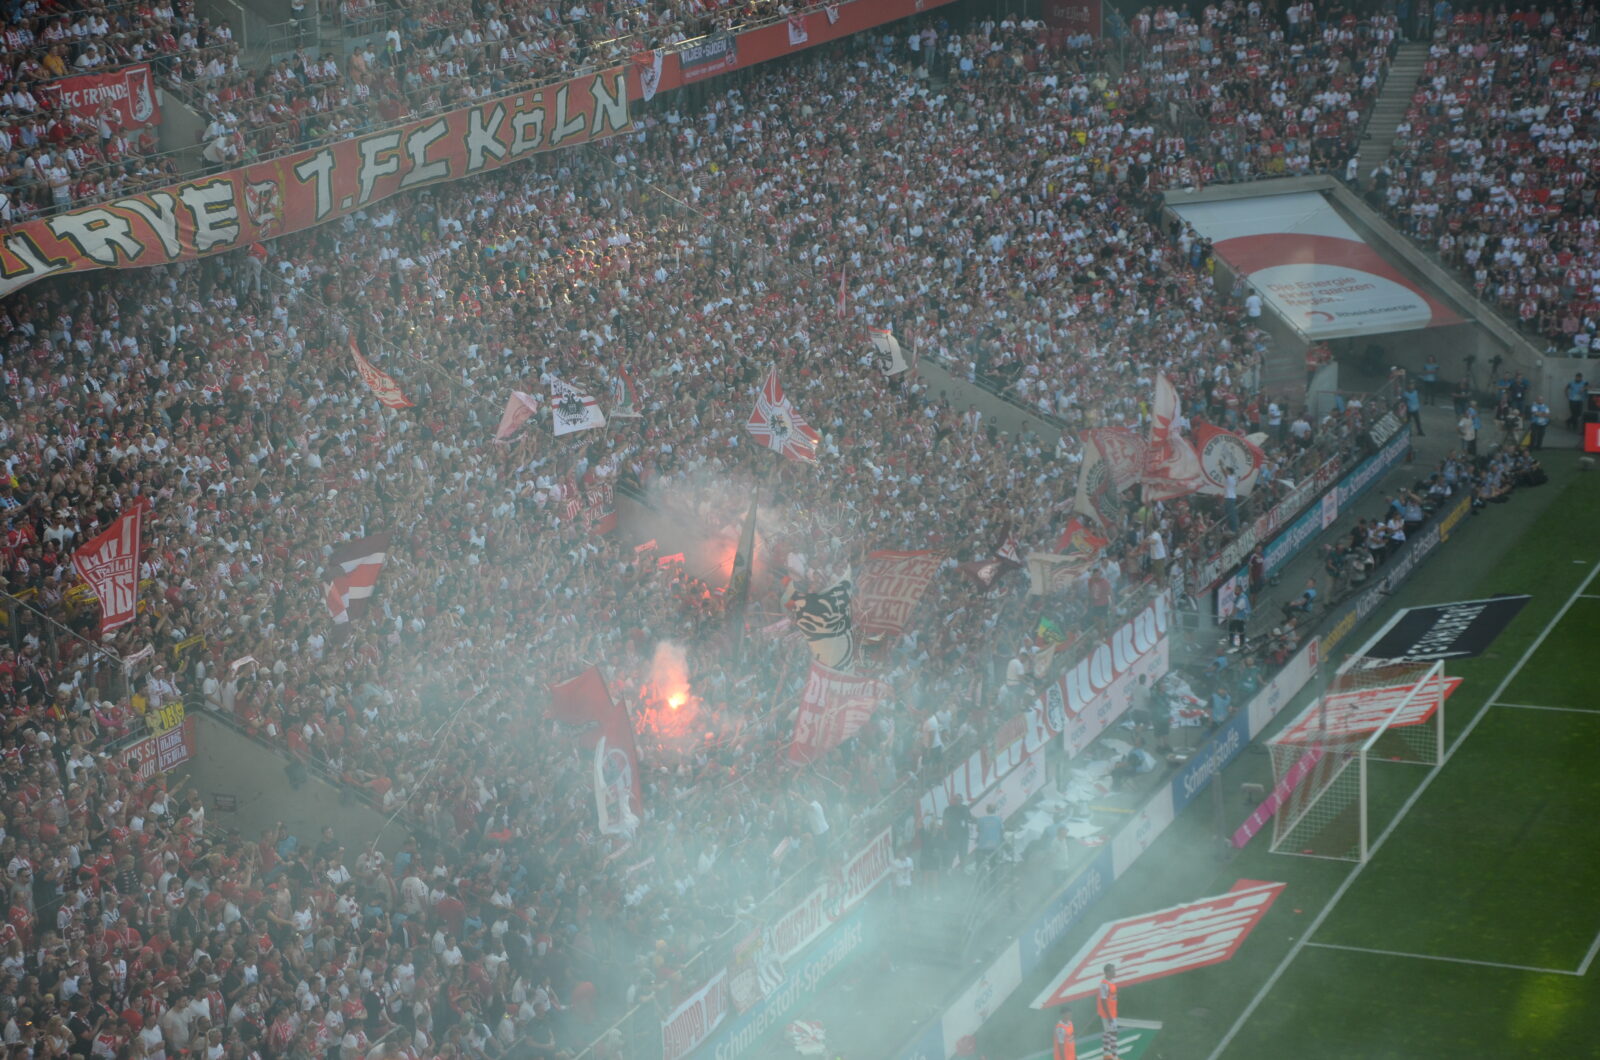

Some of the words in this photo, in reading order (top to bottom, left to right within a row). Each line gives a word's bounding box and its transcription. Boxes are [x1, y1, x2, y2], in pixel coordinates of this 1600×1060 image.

[465, 72, 630, 171] KÖLN
[1297, 276, 1357, 291] Energie
[1034, 868, 1102, 955] Schmierstoffe
[713, 919, 864, 1060] Schmierstoff-Spezialist
